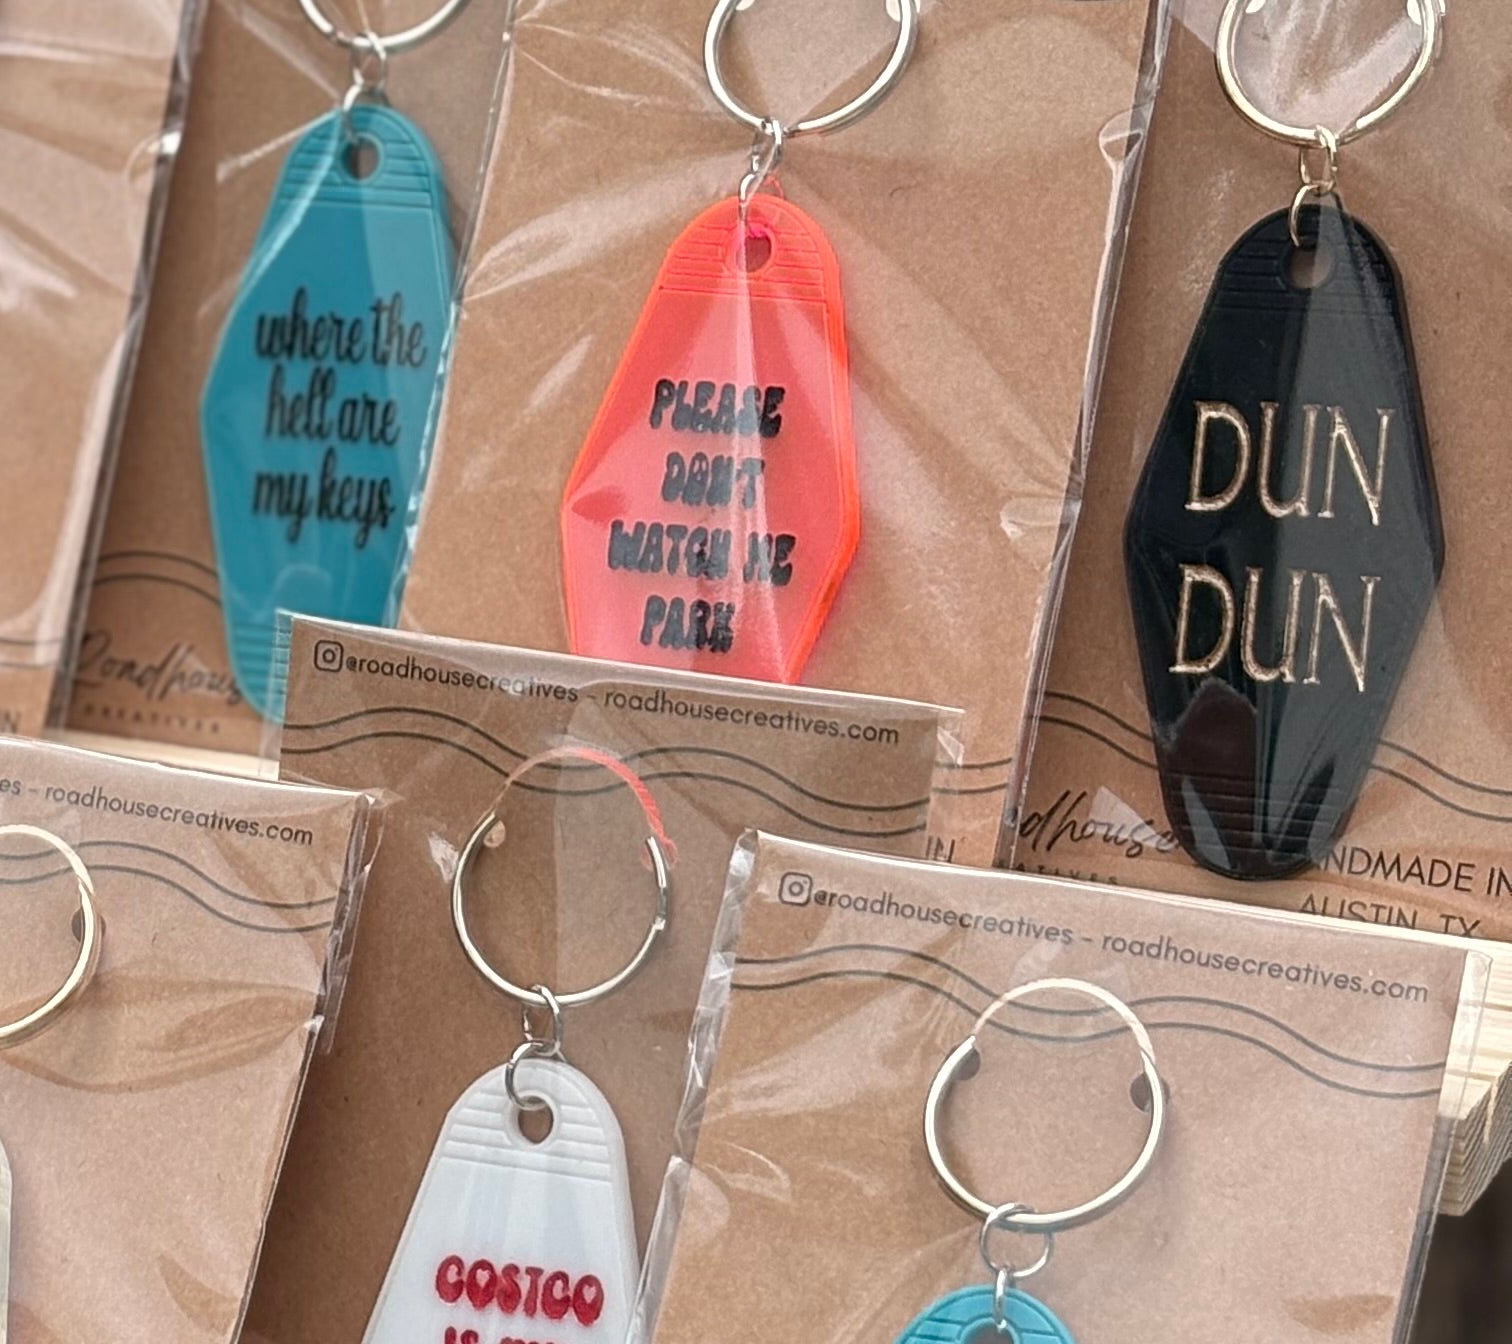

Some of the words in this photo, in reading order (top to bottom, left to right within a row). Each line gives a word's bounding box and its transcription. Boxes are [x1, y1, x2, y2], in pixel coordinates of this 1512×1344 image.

[255, 285, 366, 362] where
[369, 291, 427, 367] the
[266, 363, 337, 441] hell
[339, 392, 400, 447] are
[649, 378, 786, 438] PLEASE
[252, 470, 314, 545] my
[317, 445, 396, 550] keys
[1184, 400, 1396, 527] DUN
[607, 519, 732, 580] WATCH
[743, 532, 797, 586] ME
[640, 594, 737, 654] PARK
[1168, 563, 1382, 693] DUN
[345, 655, 579, 703] @roadhousecreatives
[604, 687, 900, 745] roadhousecreatives.com
[45, 784, 314, 847] roadhousecreatives.com
[1321, 845, 1476, 893] NDMADE
[814, 886, 1074, 946] @roadhousecreatives
[1101, 932, 1429, 1004] roadhousecreatives.com
